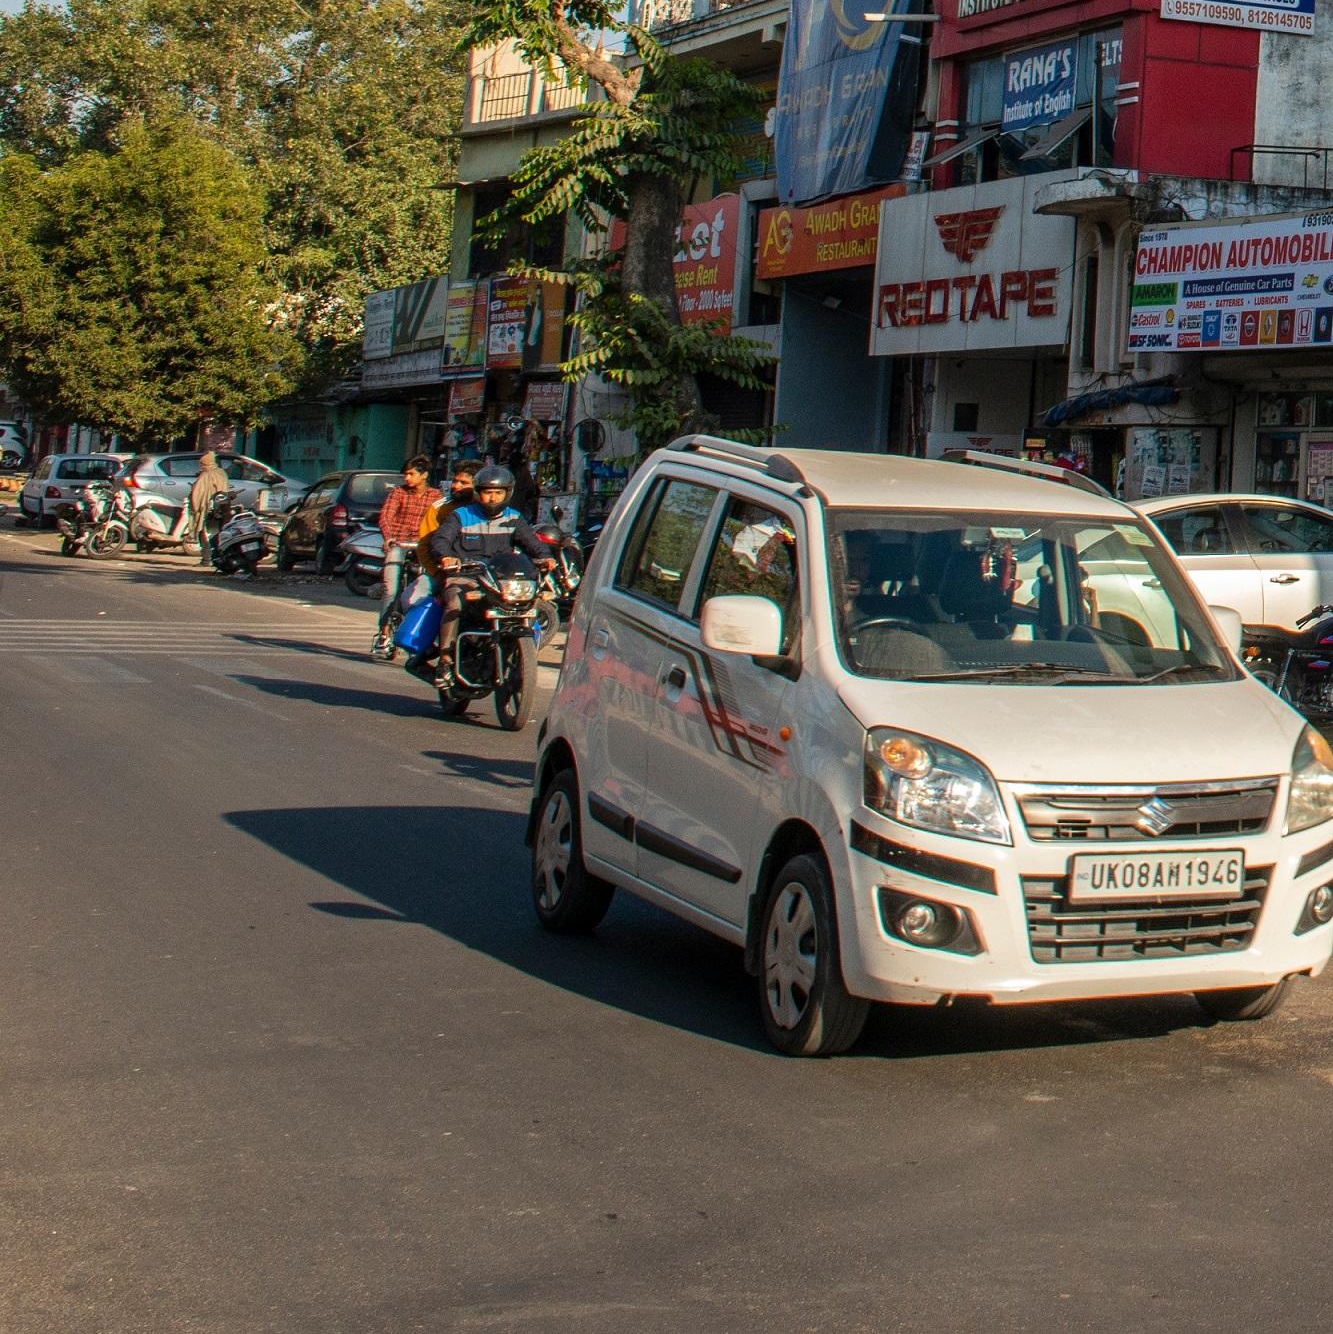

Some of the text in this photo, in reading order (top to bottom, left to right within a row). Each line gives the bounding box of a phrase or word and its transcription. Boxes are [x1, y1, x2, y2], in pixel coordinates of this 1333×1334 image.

[1175, 0, 1312, 30] 9557109590, 8126145705
[1007, 47, 1072, 94] RANA'S
[1003, 89, 1071, 123] Institute of English
[805, 207, 847, 236] AWADH
[816, 236, 878, 264] RESTAURANT
[1139, 232, 1154, 243] Since
[1136, 240, 1223, 277] CHAMPION
[696, 262, 719, 287] Rent
[1184, 277, 1293, 295] A House of Genuine Car Parts
[877, 267, 1059, 329] REDTAPE
[1186, 295, 1289, 310] SPARES BATTERIES LUBRICANTS
[1137, 313, 1161, 327] Castrol
